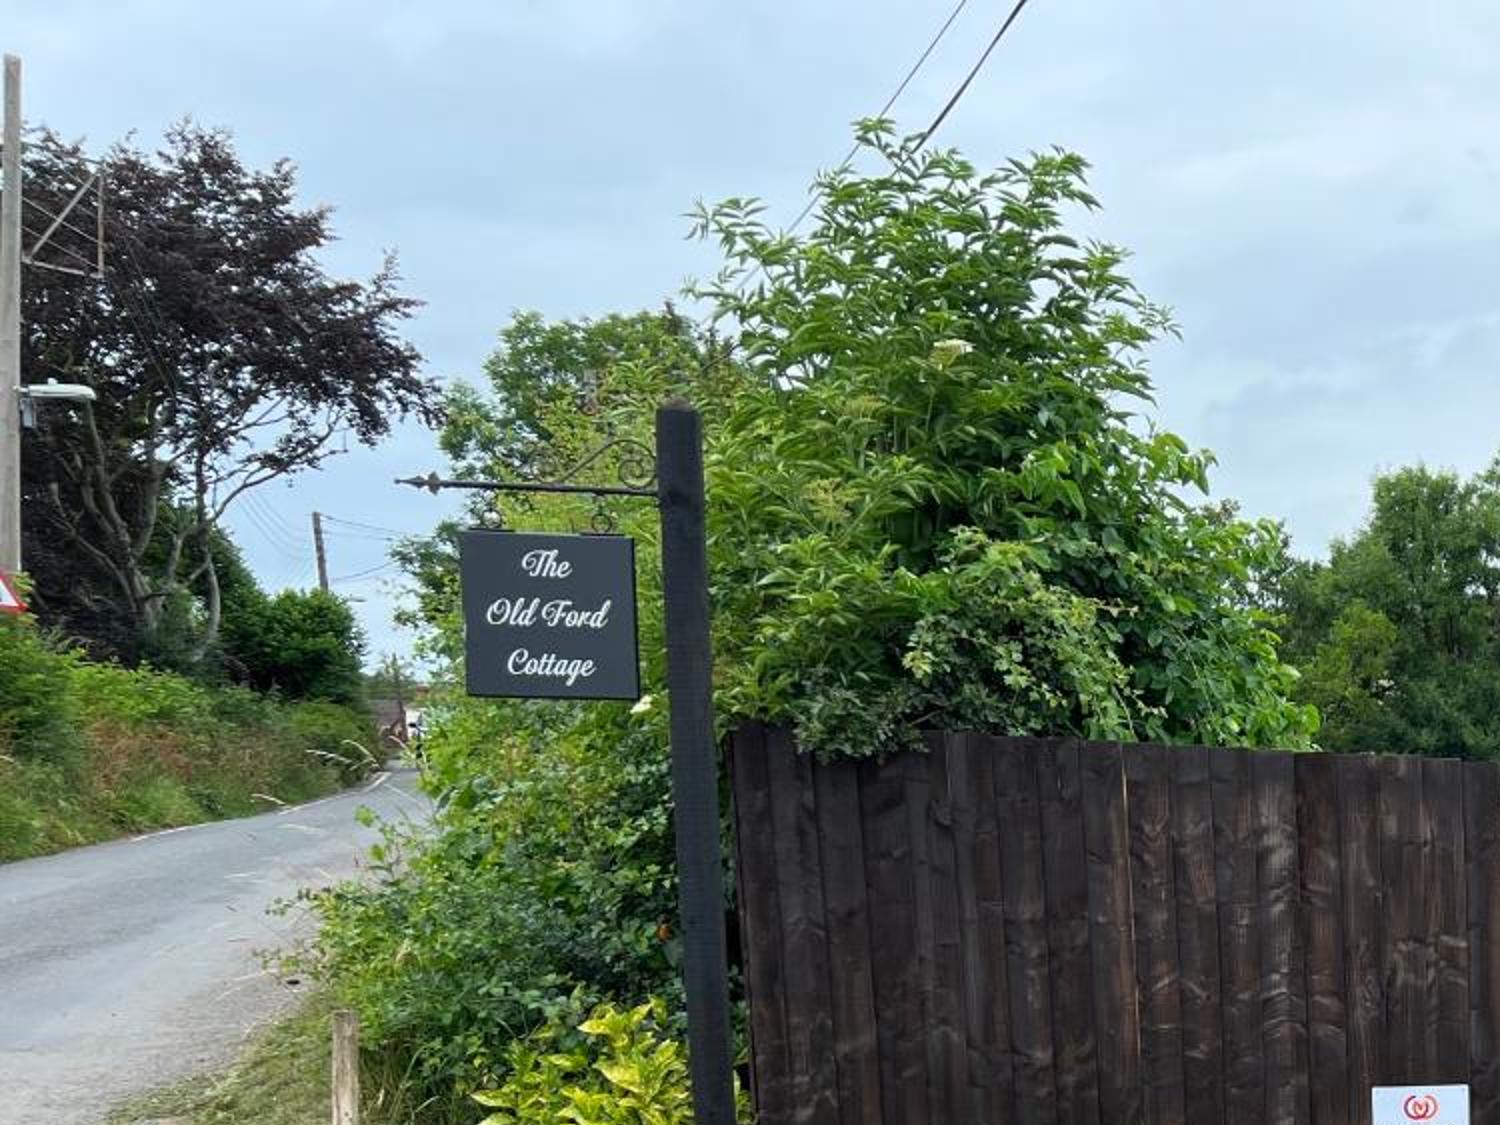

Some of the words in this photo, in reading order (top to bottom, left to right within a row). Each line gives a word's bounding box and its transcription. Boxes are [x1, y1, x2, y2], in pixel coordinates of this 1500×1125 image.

[521, 549, 573, 579] The
[486, 597, 541, 627] Old
[541, 599, 612, 629] Ford
[507, 648, 597, 687] Cottage
